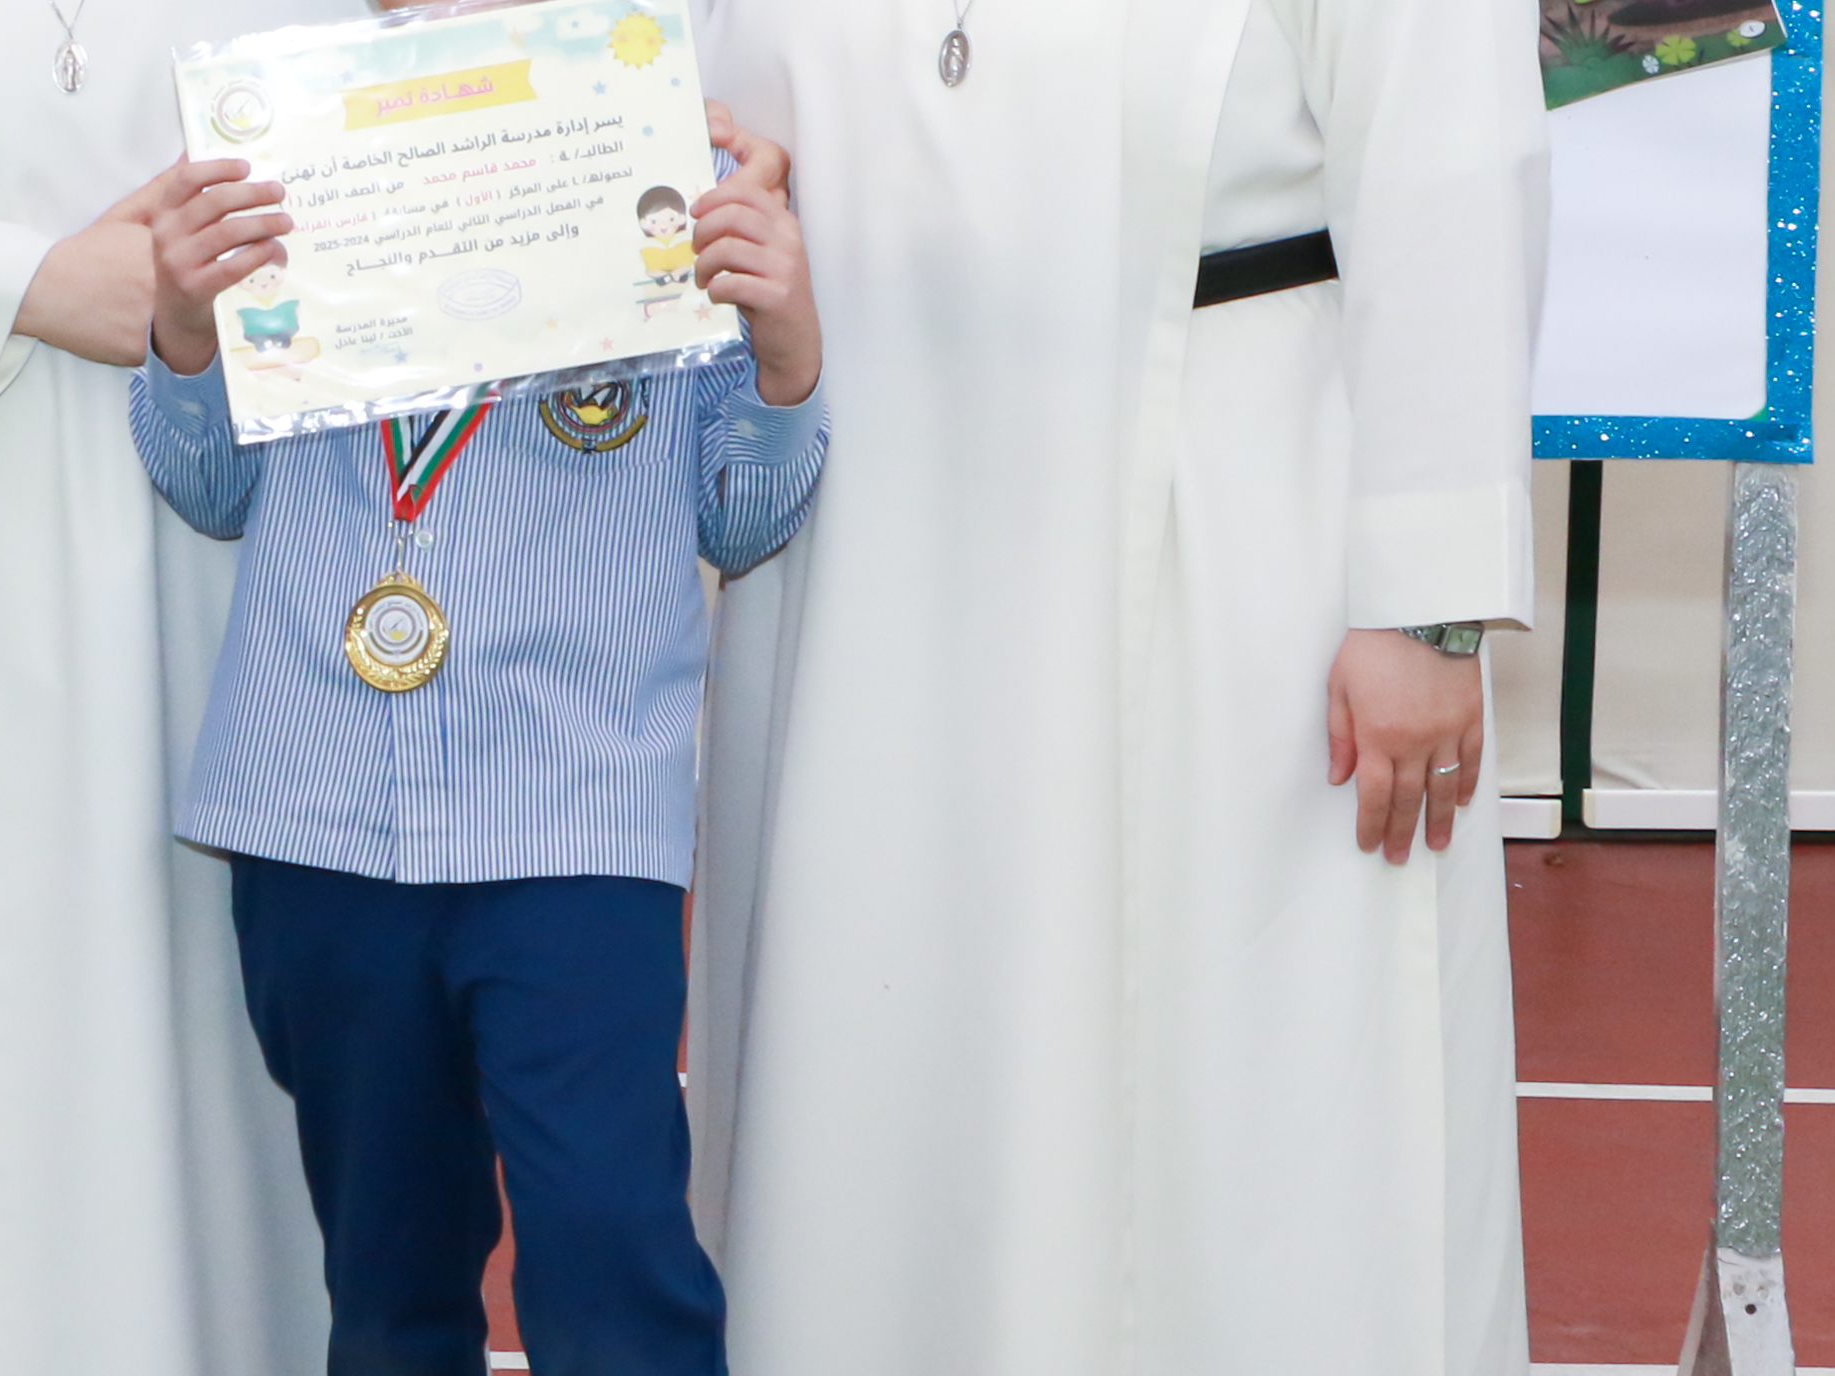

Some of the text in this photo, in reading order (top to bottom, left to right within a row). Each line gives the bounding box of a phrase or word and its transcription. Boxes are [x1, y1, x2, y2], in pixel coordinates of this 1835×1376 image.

[419, 75, 495, 104] شهادة
[555, 117, 590, 137] إدارة
[593, 115, 624, 132] يسر
[451, 132, 497, 154] الراشد
[501, 128, 552, 144] مدرسة
[342, 149, 393, 171] الخاصة
[397, 141, 446, 168] الصالح
[321, 154, 338, 179] أن
[462, 162, 498, 182] قاسم
[502, 158, 537, 172] محمد
[385, 179, 405, 195] من
[423, 171, 457, 186] محمد
[545, 178, 569, 194] على
[307, 188, 340, 208] الأول
[344, 181, 381, 198] الصف
[465, 189, 494, 208] الأول
[508, 181, 542, 200] المركز
[430, 199, 450, 214] في
[545, 198, 582, 216] الفصل
[584, 195, 604, 212] في
[494, 204, 542, 226] الدراسي
[374, 225, 421, 246] الدراسي
[425, 220, 453, 236] للعام
[545, 222, 580, 242] وإلى
[483, 237, 504, 252] من
[509, 230, 541, 247] مزيد
[335, 319, 377, 335] المدرسة
